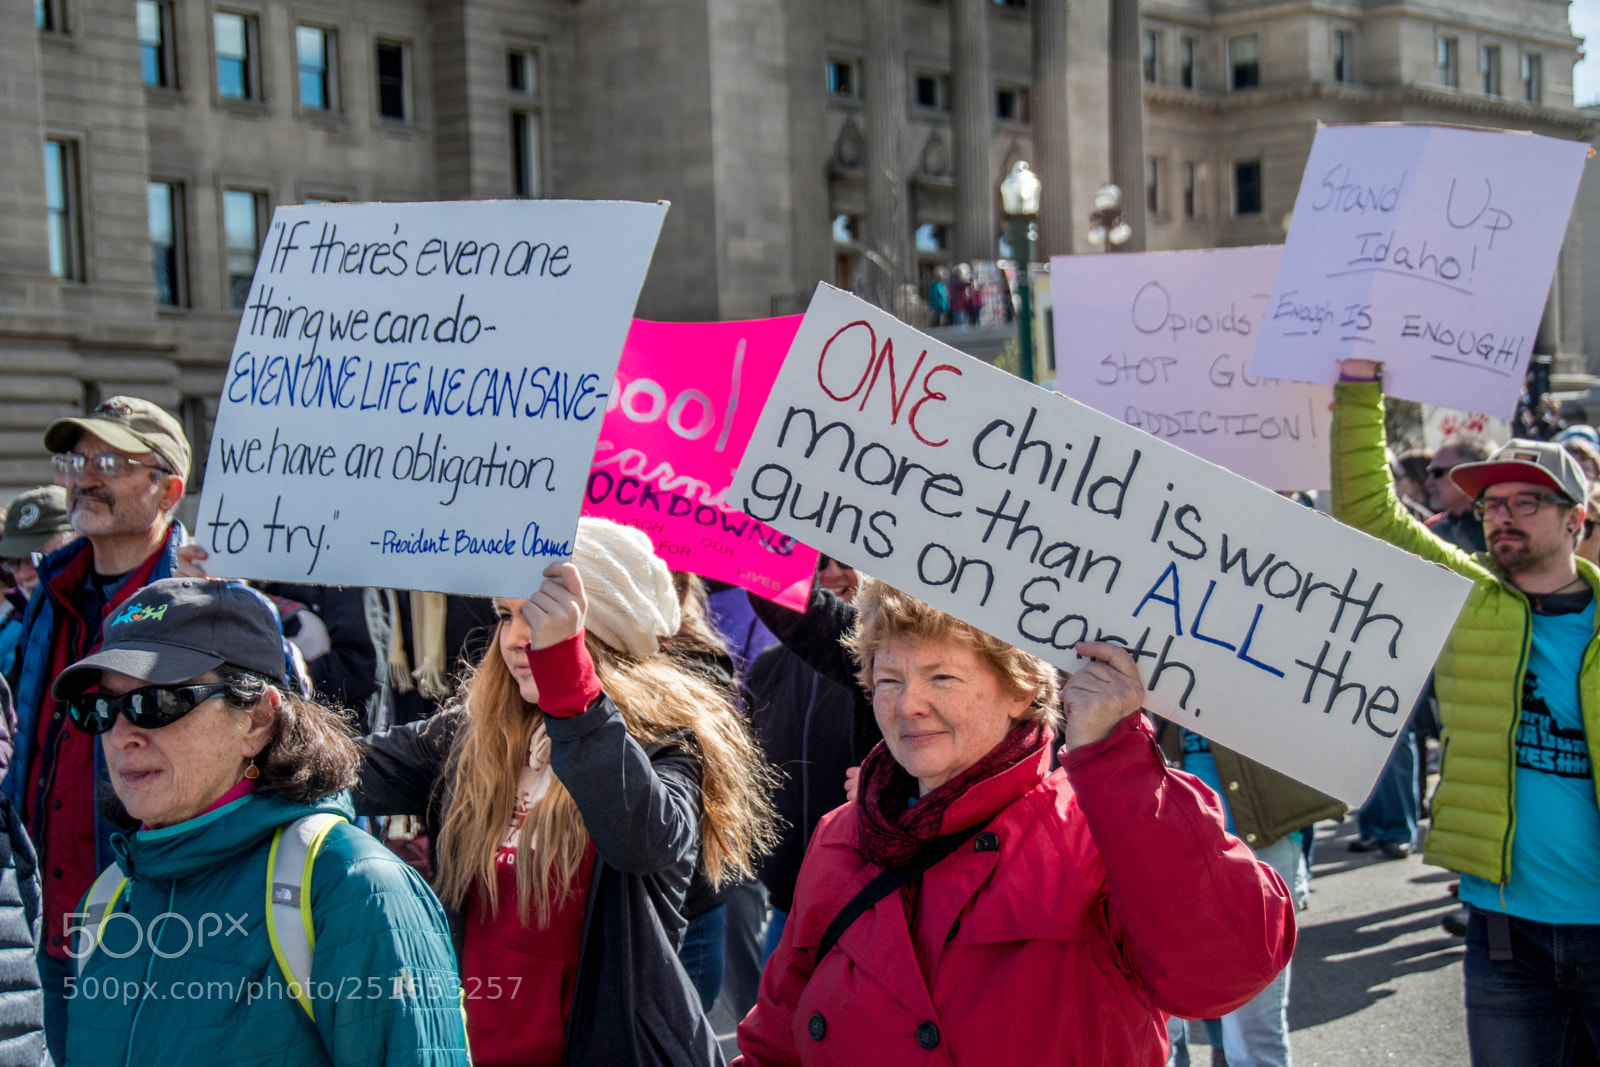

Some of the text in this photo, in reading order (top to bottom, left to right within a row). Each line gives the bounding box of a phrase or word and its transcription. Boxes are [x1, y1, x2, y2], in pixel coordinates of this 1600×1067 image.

[310, 222, 408, 275] there's
[415, 238, 500, 276] even
[504, 240, 572, 277] one
[1347, 229, 1477, 281] Idaho!
[248, 284, 496, 367] thing we can do-
[1131, 280, 1251, 341] Opioids
[227, 351, 301, 407] EVEN
[302, 356, 361, 410] ONE
[361, 360, 420, 414] LIFE
[424, 365, 466, 416] WE
[467, 367, 527, 419] CAN
[1209, 353, 1279, 388] GU
[1125, 397, 1317, 448] ADDICTION!
[221, 427, 555, 505] we have an obligation
[817, 320, 1403, 659] ONE child is worth
[208, 493, 249, 553] to
[454, 529, 516, 556] Barack
[587, 470, 798, 556] OCKDOWNS
[742, 463, 898, 559] guns
[917, 541, 995, 607] on
[658, 540, 691, 558] FOR
[701, 537, 735, 558] OUR
[777, 405, 1399, 738] more than ALL the
